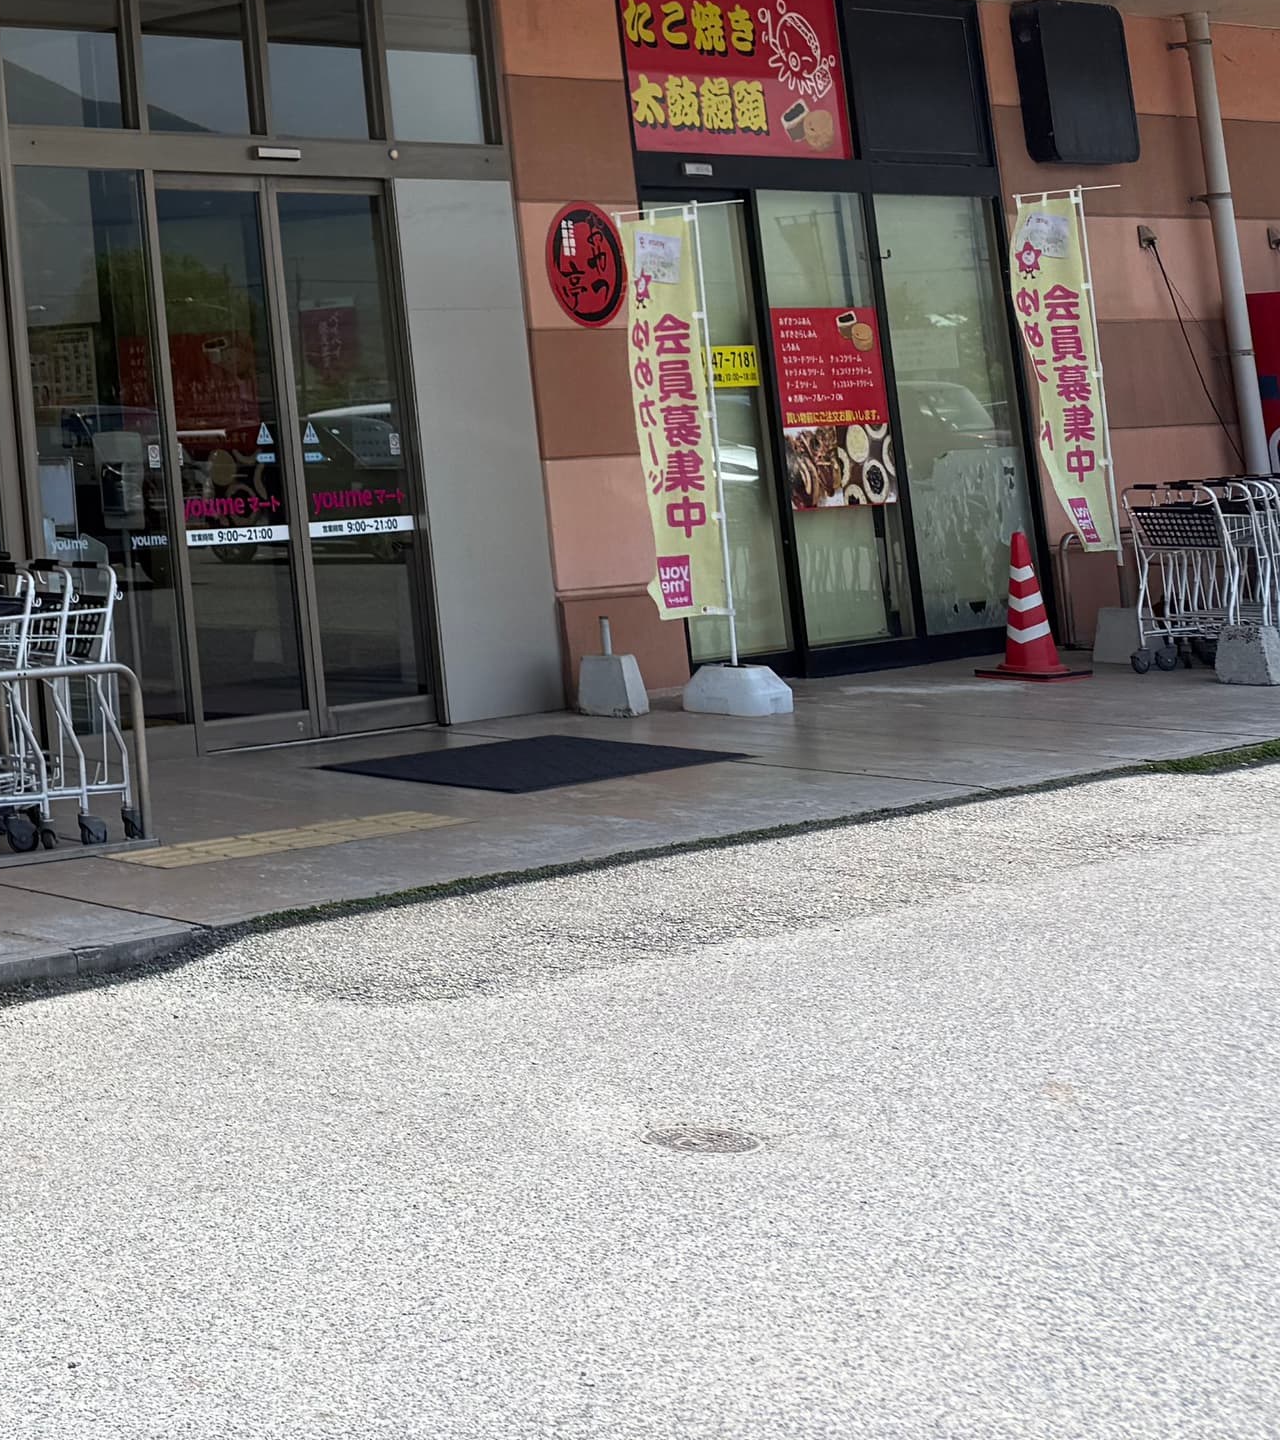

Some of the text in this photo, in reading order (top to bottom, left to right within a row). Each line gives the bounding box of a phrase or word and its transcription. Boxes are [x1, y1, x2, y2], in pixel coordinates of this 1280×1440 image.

[631, 73, 769, 133] 太鼓饅頭
[559, 260, 589, 312] 亭
[183, 495, 281, 522] youme マート
[311, 487, 405, 516] youme マート
[50, 538, 89, 553] youme
[131, 533, 168, 548] youme
